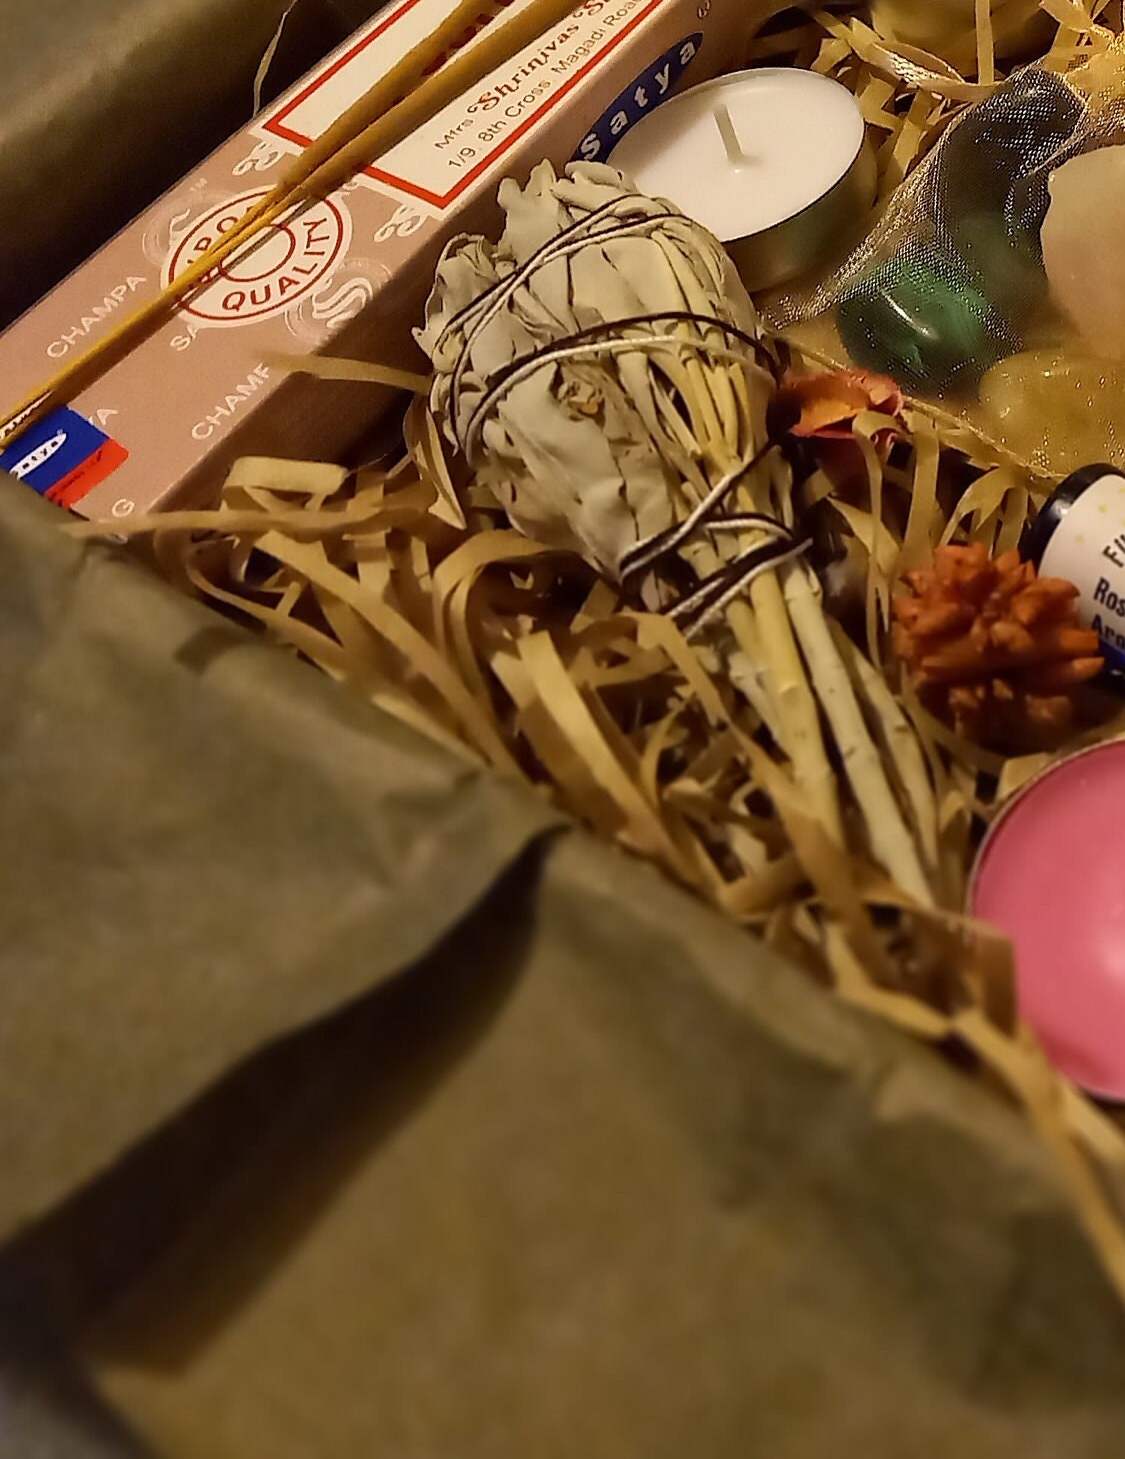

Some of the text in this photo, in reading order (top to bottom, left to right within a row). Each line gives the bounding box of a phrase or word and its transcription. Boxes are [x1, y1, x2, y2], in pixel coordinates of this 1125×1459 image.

[467, 23, 579, 115] Shrinivas
[478, 120, 507, 142] 8th
[551, 29, 606, 74] Magadi
[580, 42, 696, 161] Satya
[222, 218, 331, 311] QUALITY
[46, 275, 147, 359] CHAMPA
